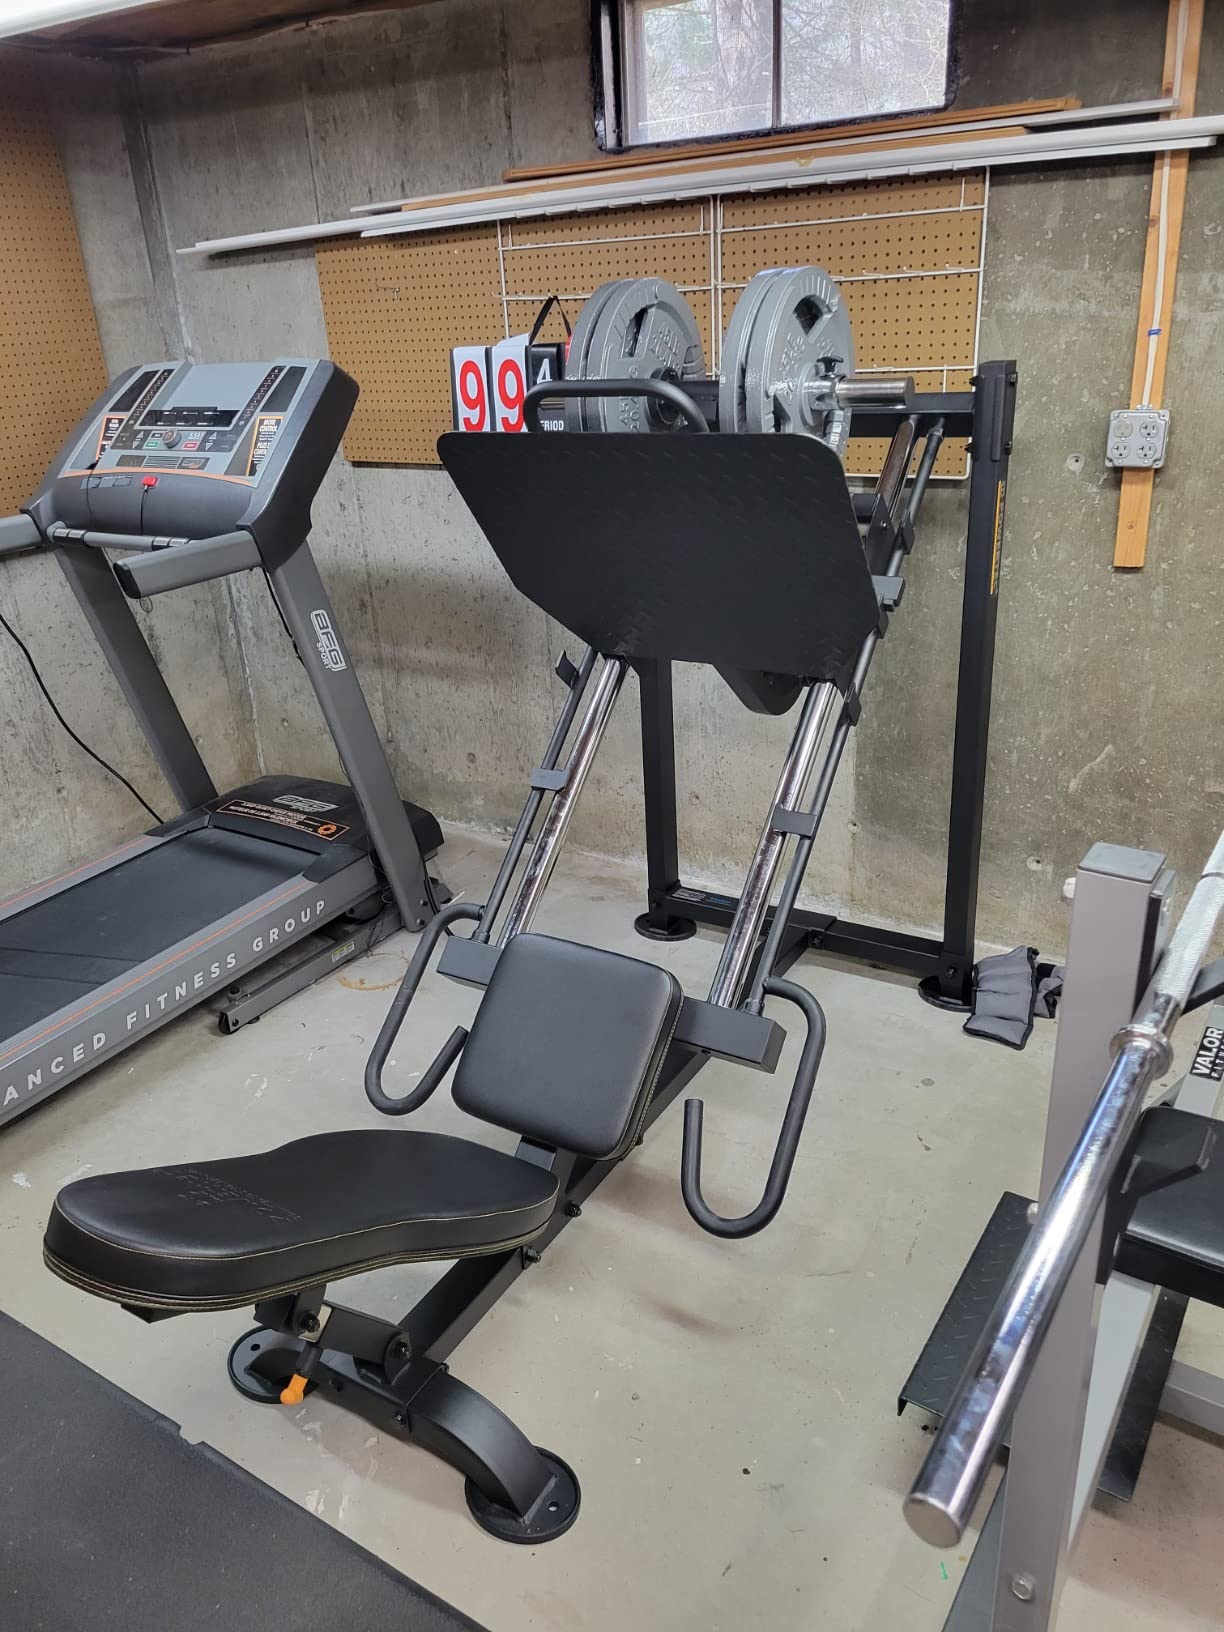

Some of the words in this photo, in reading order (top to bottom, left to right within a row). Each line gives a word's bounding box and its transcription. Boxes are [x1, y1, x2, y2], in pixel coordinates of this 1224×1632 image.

[537, 358, 553, 384] 4
[459, 360, 486, 432] 9
[498, 358, 526, 432] 9
[540, 420, 565, 432] RIOD
[316, 642, 332, 670] SPORT
[3, 1032, 107, 1107] ANCED
[126, 952, 236, 1031] FITNESS
[252, 900, 325, 953] GROUP
[1191, 1027, 1224, 1075] VALOR
[1211, 1038, 1224, 1078] FITN
